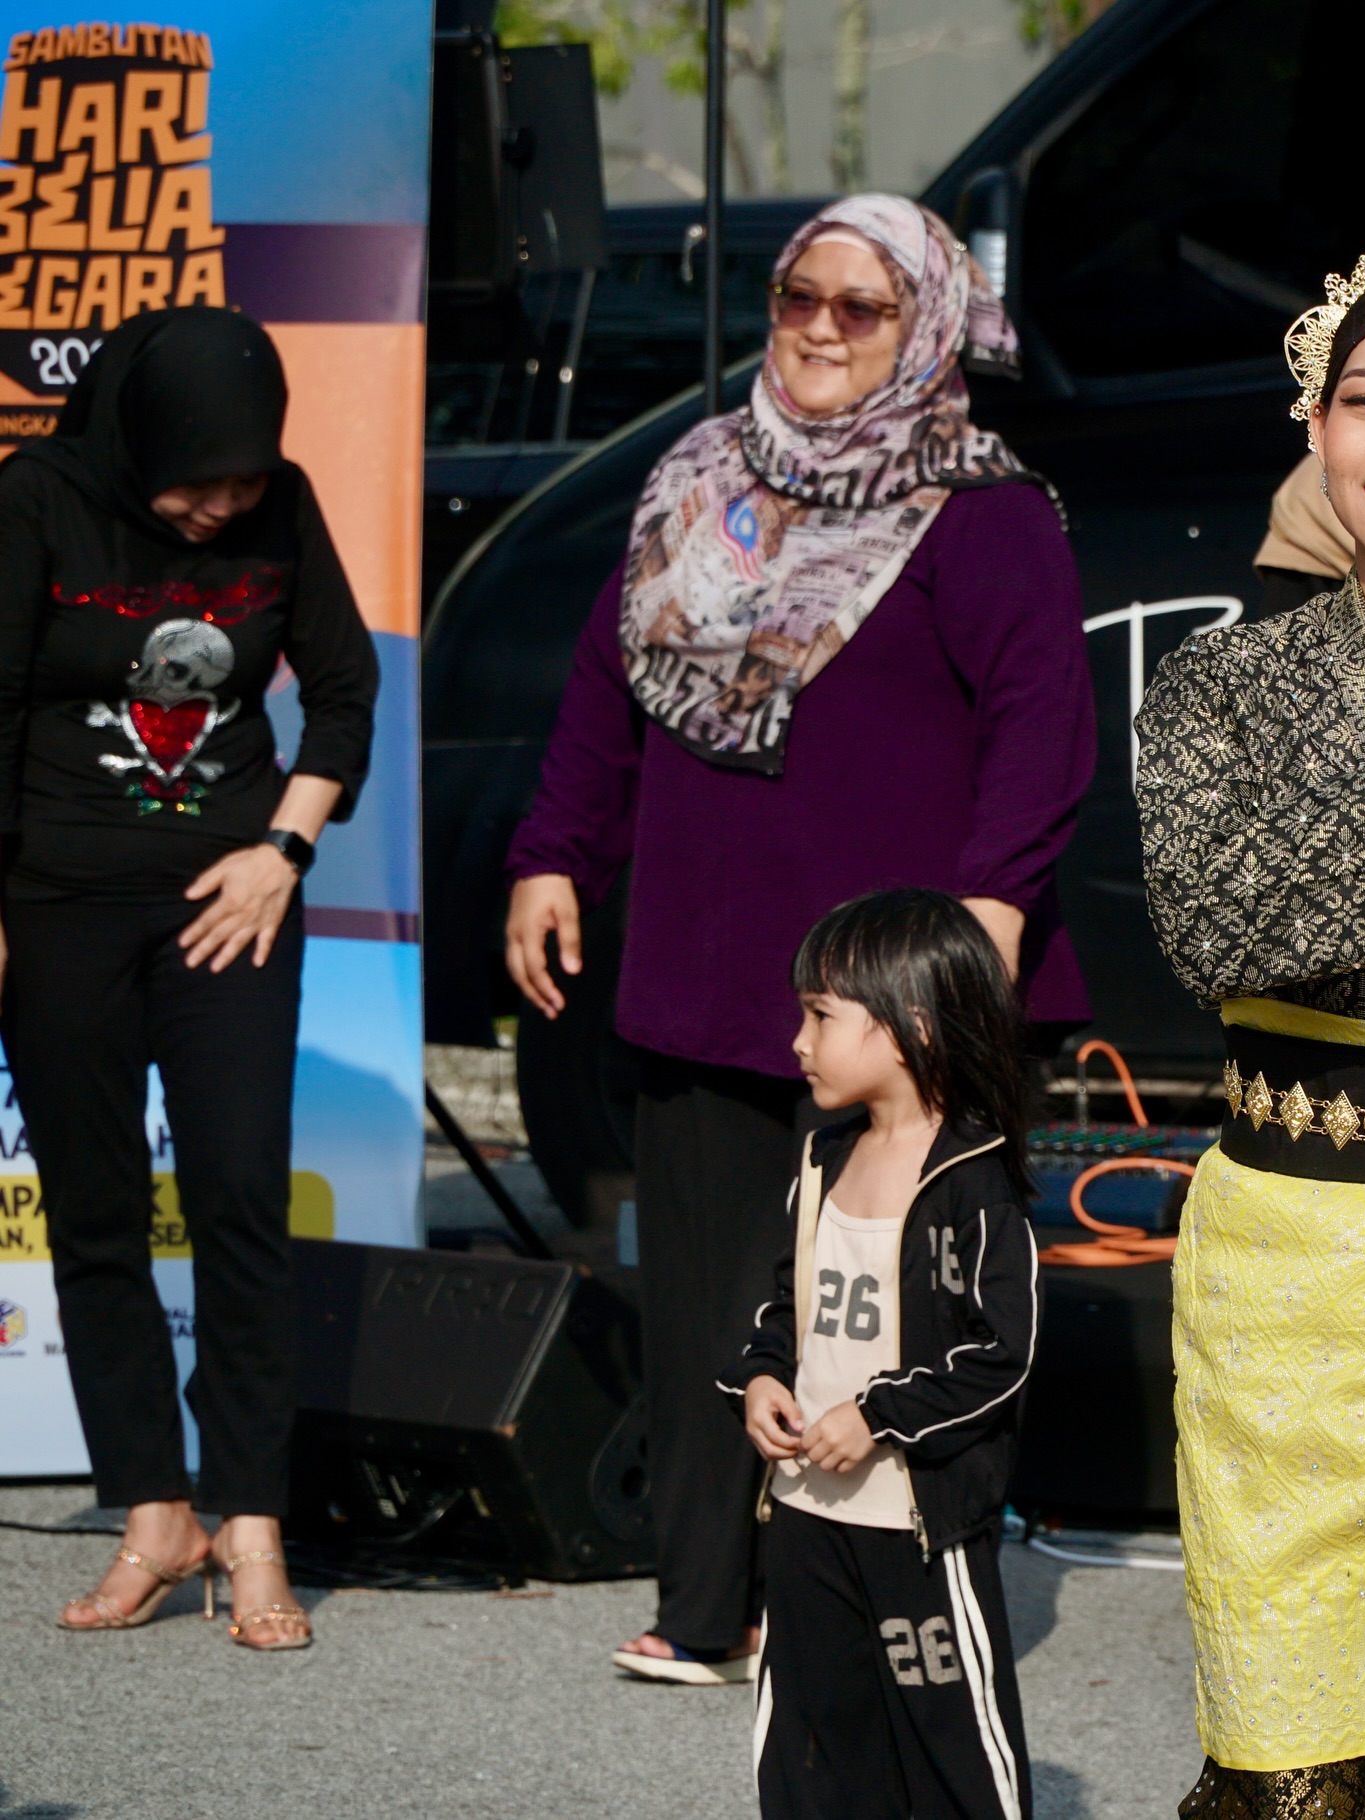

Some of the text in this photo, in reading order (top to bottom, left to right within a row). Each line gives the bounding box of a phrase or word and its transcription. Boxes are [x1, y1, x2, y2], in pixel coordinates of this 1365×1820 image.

[4, 22, 214, 70] SAMBUTAN
[0, 68, 213, 174] HARI
[30, 338, 103, 385] 20
[813, 1268, 881, 1341] 26
[879, 1615, 962, 1687] 26
